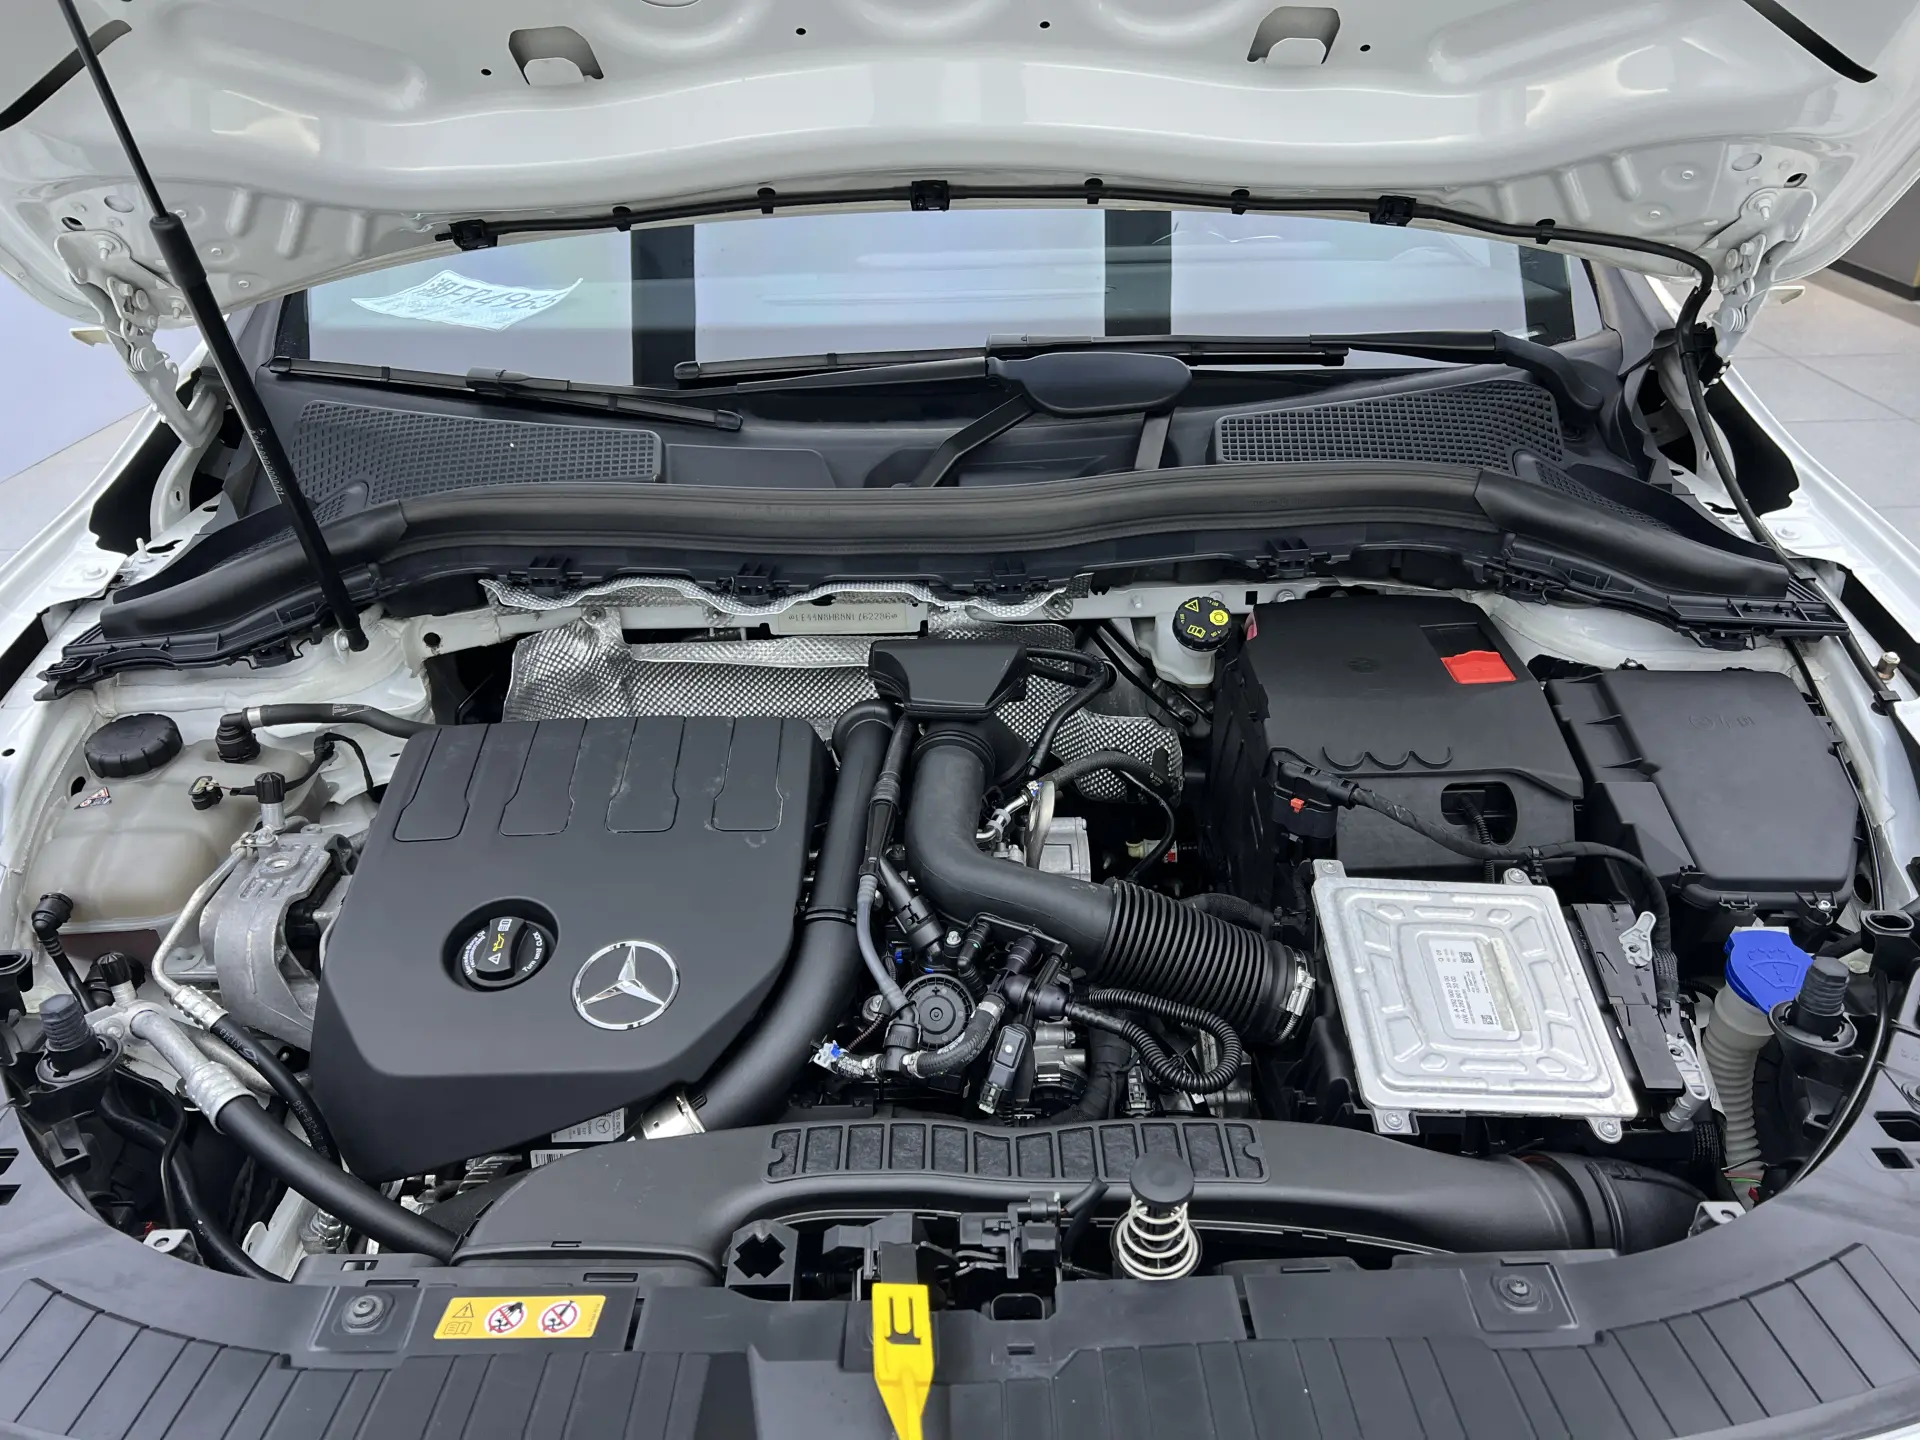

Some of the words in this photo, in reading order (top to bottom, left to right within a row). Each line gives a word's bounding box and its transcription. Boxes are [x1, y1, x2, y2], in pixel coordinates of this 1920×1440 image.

[533, 931, 543, 947] CLICK
[534, 948, 542, 960] until
[522, 960, 537, 972] Turn
